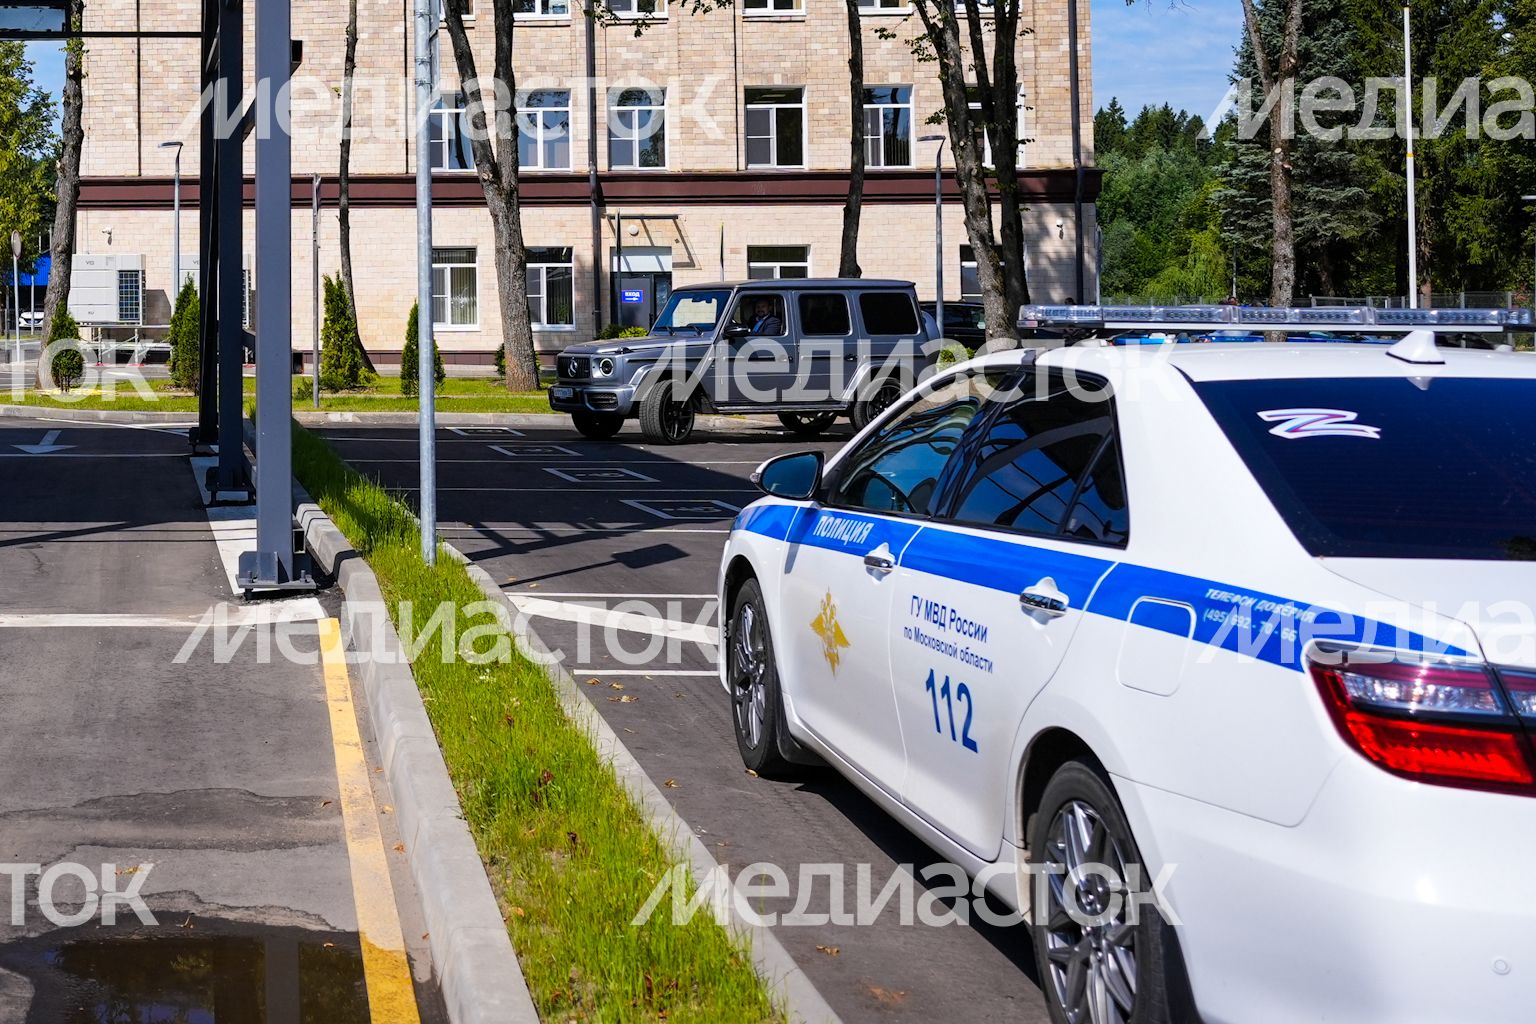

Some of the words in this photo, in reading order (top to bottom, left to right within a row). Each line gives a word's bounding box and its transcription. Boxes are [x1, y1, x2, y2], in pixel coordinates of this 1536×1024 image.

[813, 516, 874, 546] ПОЛИЦИЯ
[910, 595, 923, 618] ГУ
[924, 600, 946, 632] МВД
[949, 608, 988, 644] России
[903, 626, 913, 640] по
[913, 626, 958, 660] Московской
[959, 647, 994, 674] области
[925, 668, 979, 754] 112
